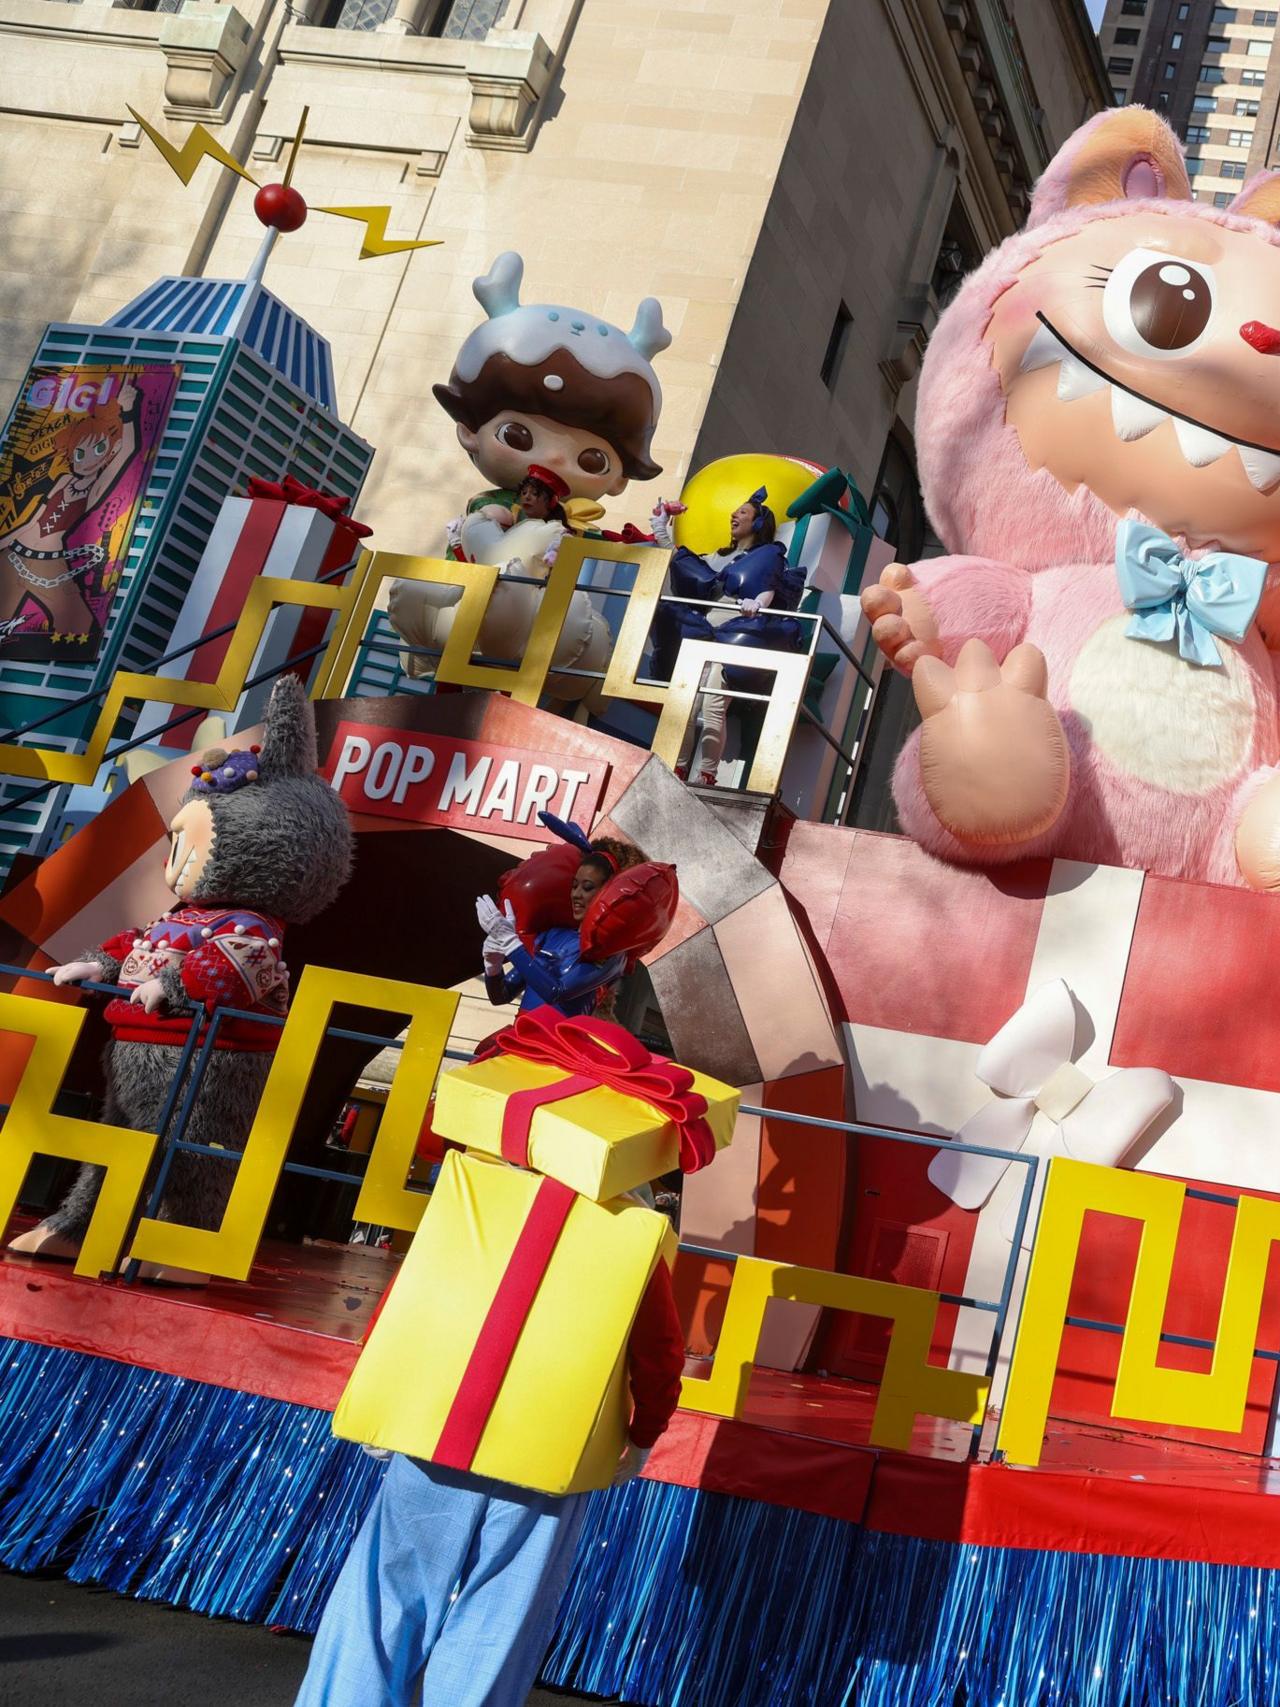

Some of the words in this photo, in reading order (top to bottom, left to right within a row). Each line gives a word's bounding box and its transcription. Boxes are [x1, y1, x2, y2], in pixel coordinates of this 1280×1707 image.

[26, 373, 116, 413] GIGI
[330, 735, 436, 804] POP
[437, 752, 590, 827] MART
